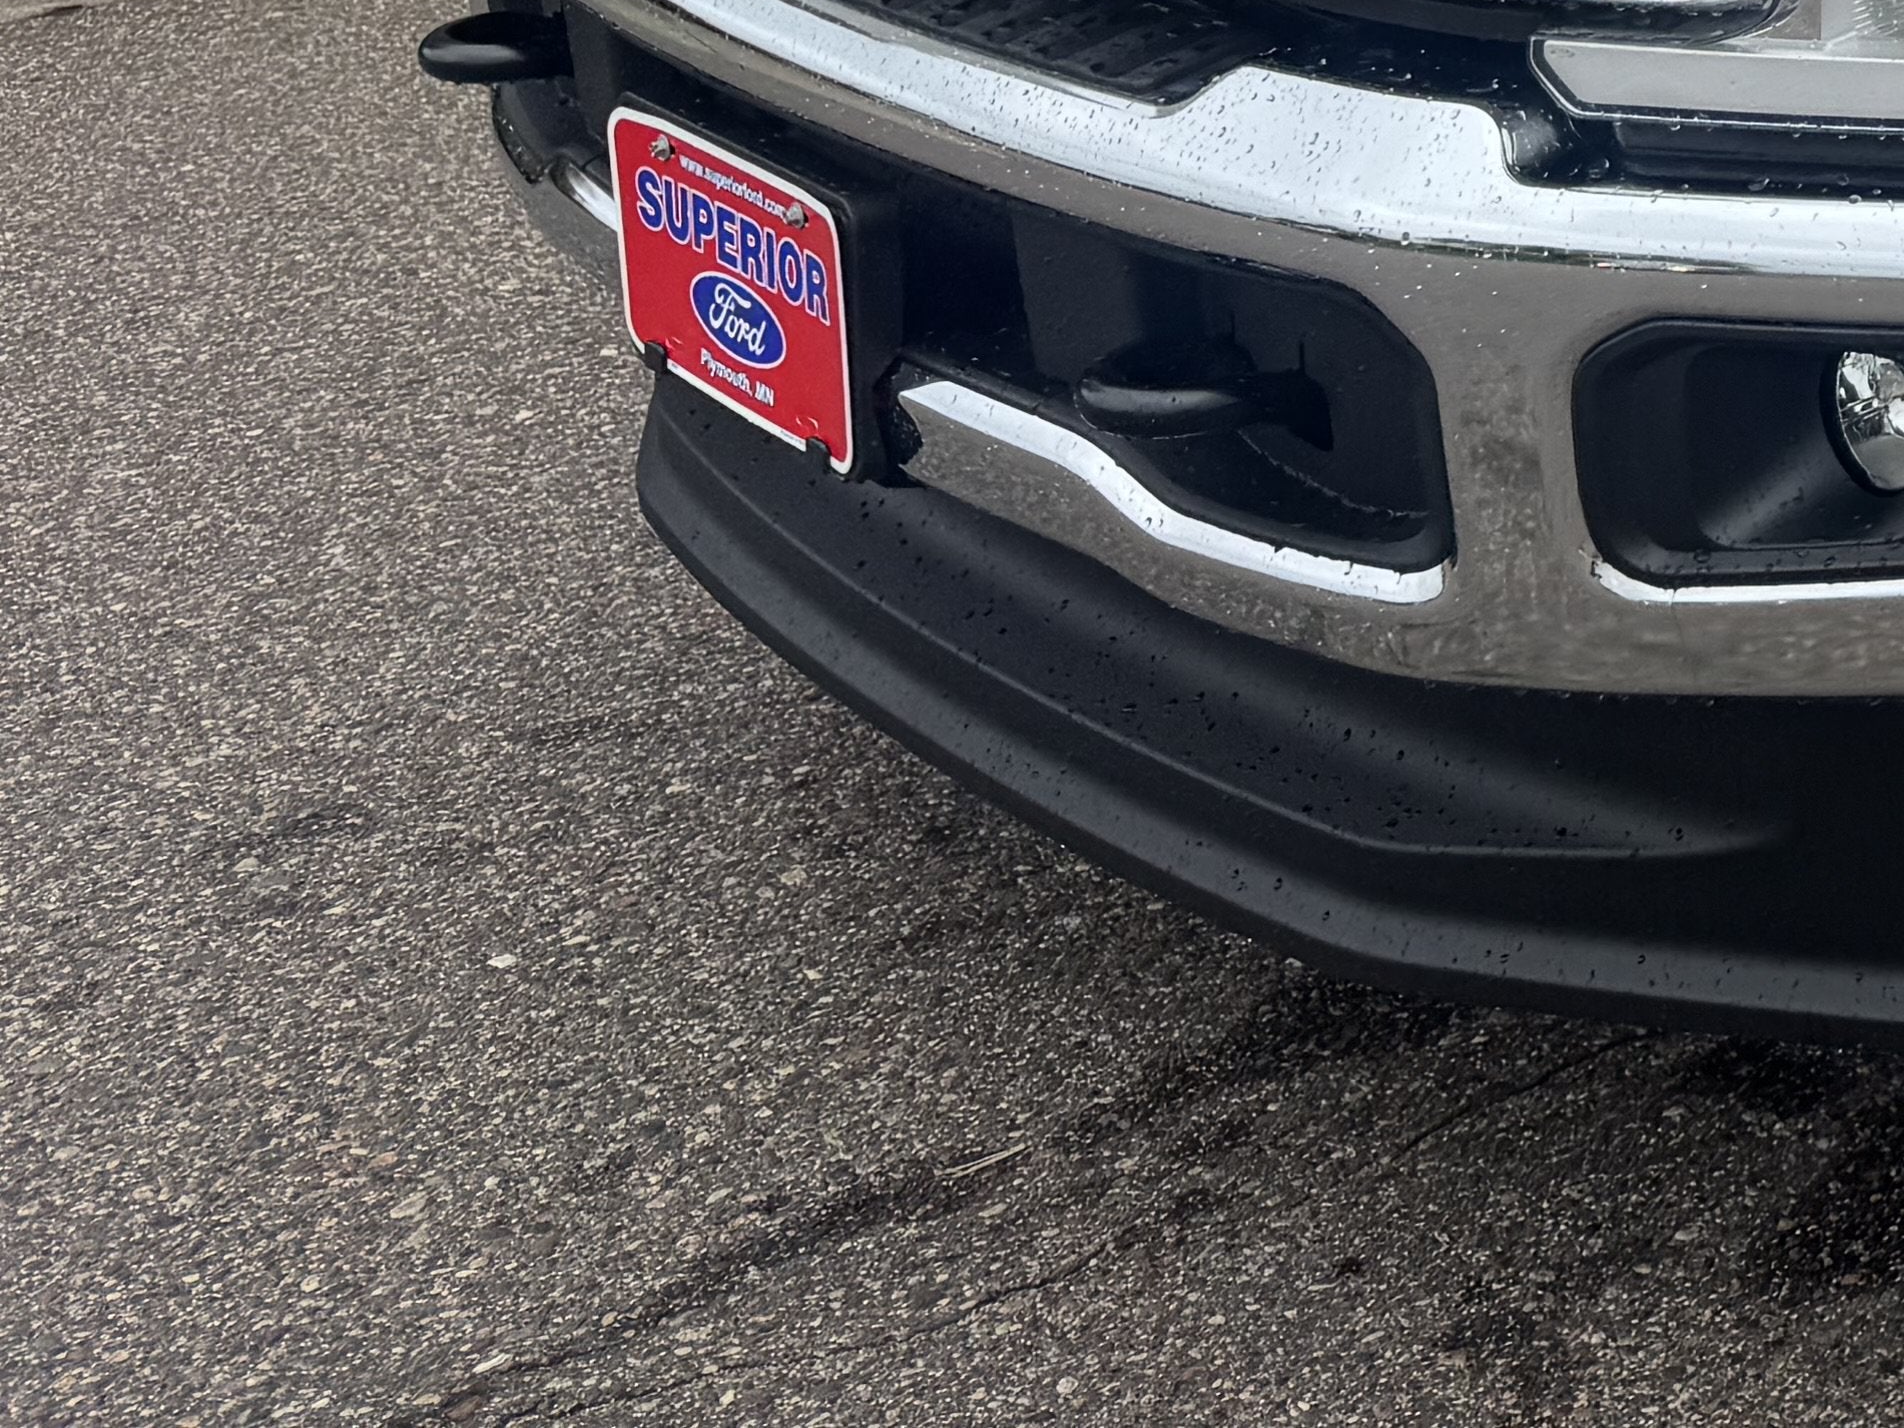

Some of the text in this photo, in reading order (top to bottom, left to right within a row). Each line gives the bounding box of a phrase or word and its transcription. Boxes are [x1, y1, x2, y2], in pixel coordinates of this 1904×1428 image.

[635, 165, 831, 326] SUPERIOR
[708, 282, 767, 357] Ford
[754, 380, 775, 407] MN
